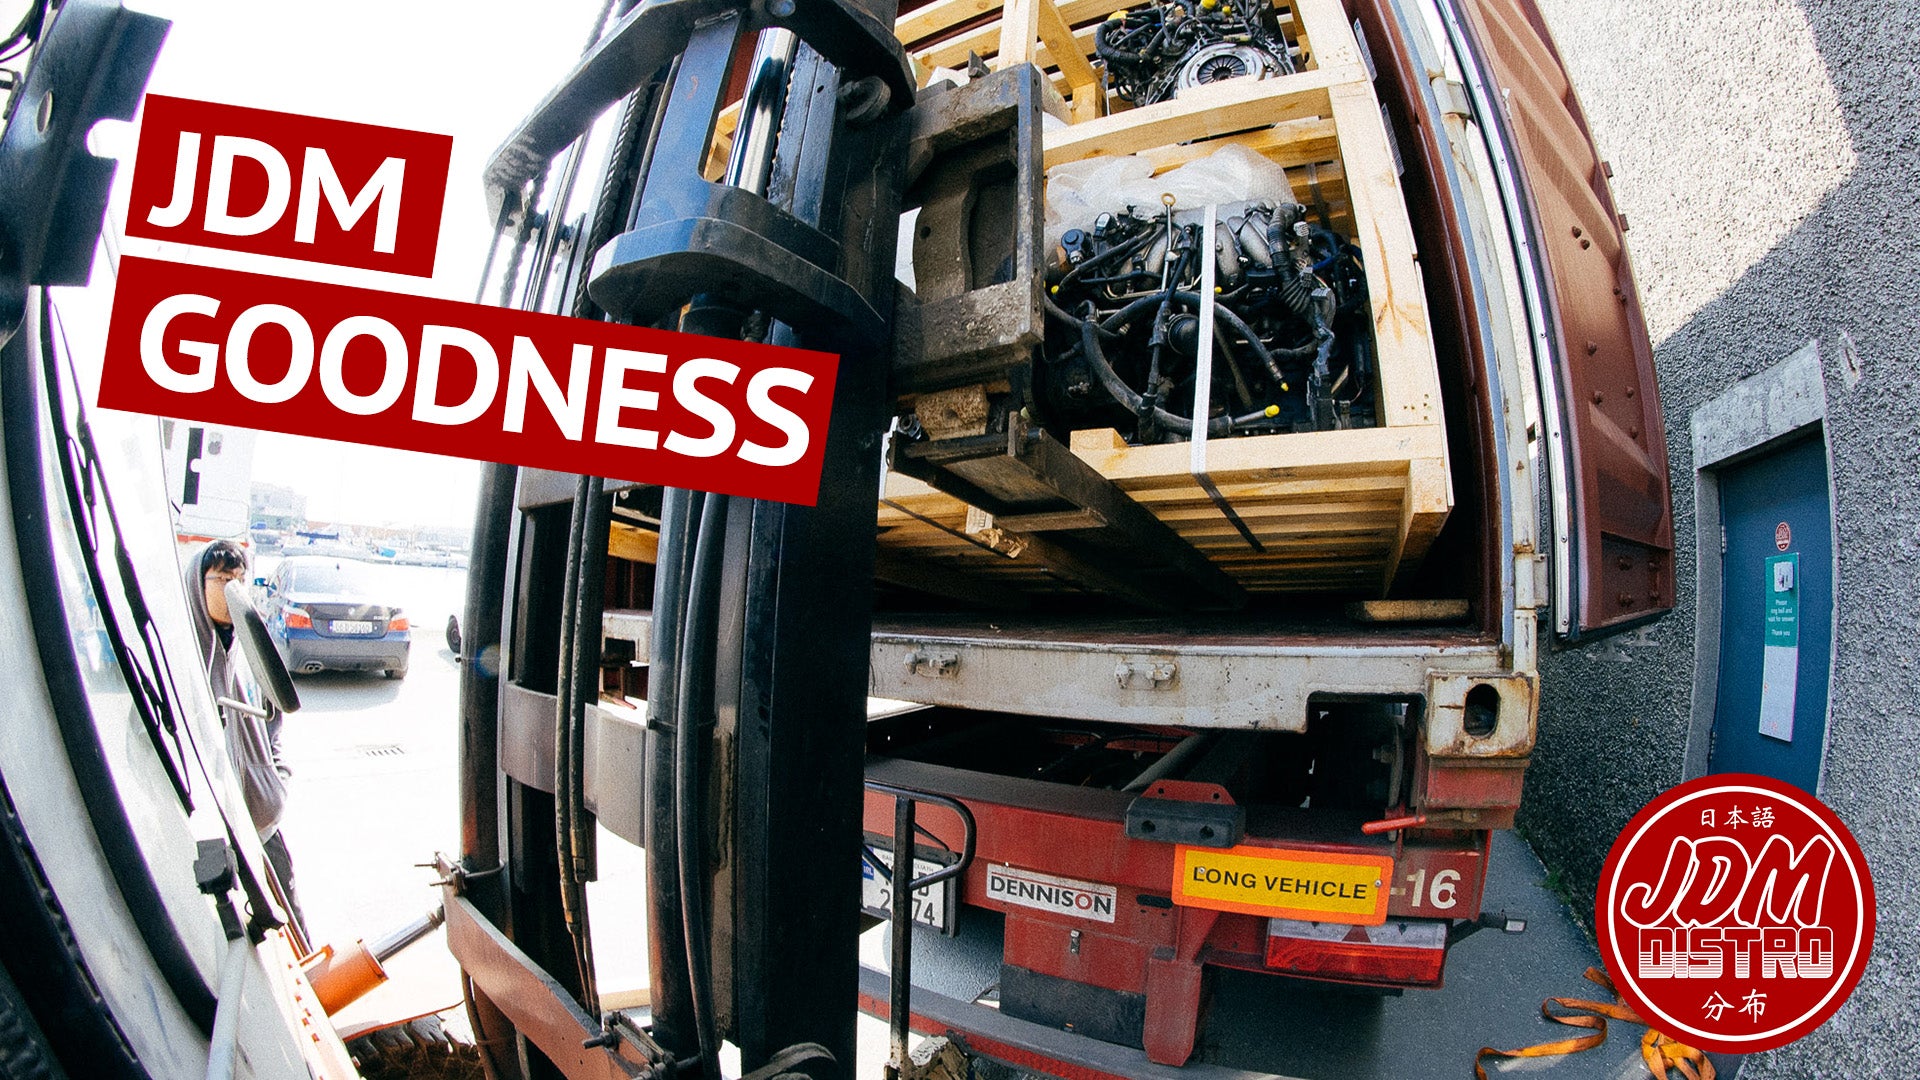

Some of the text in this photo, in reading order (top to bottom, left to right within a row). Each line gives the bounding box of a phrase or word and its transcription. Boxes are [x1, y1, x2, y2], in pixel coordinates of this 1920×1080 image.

[990, 875, 1112, 915] DENNISON
[1193, 866, 1368, 900] LONG VEHICLE
